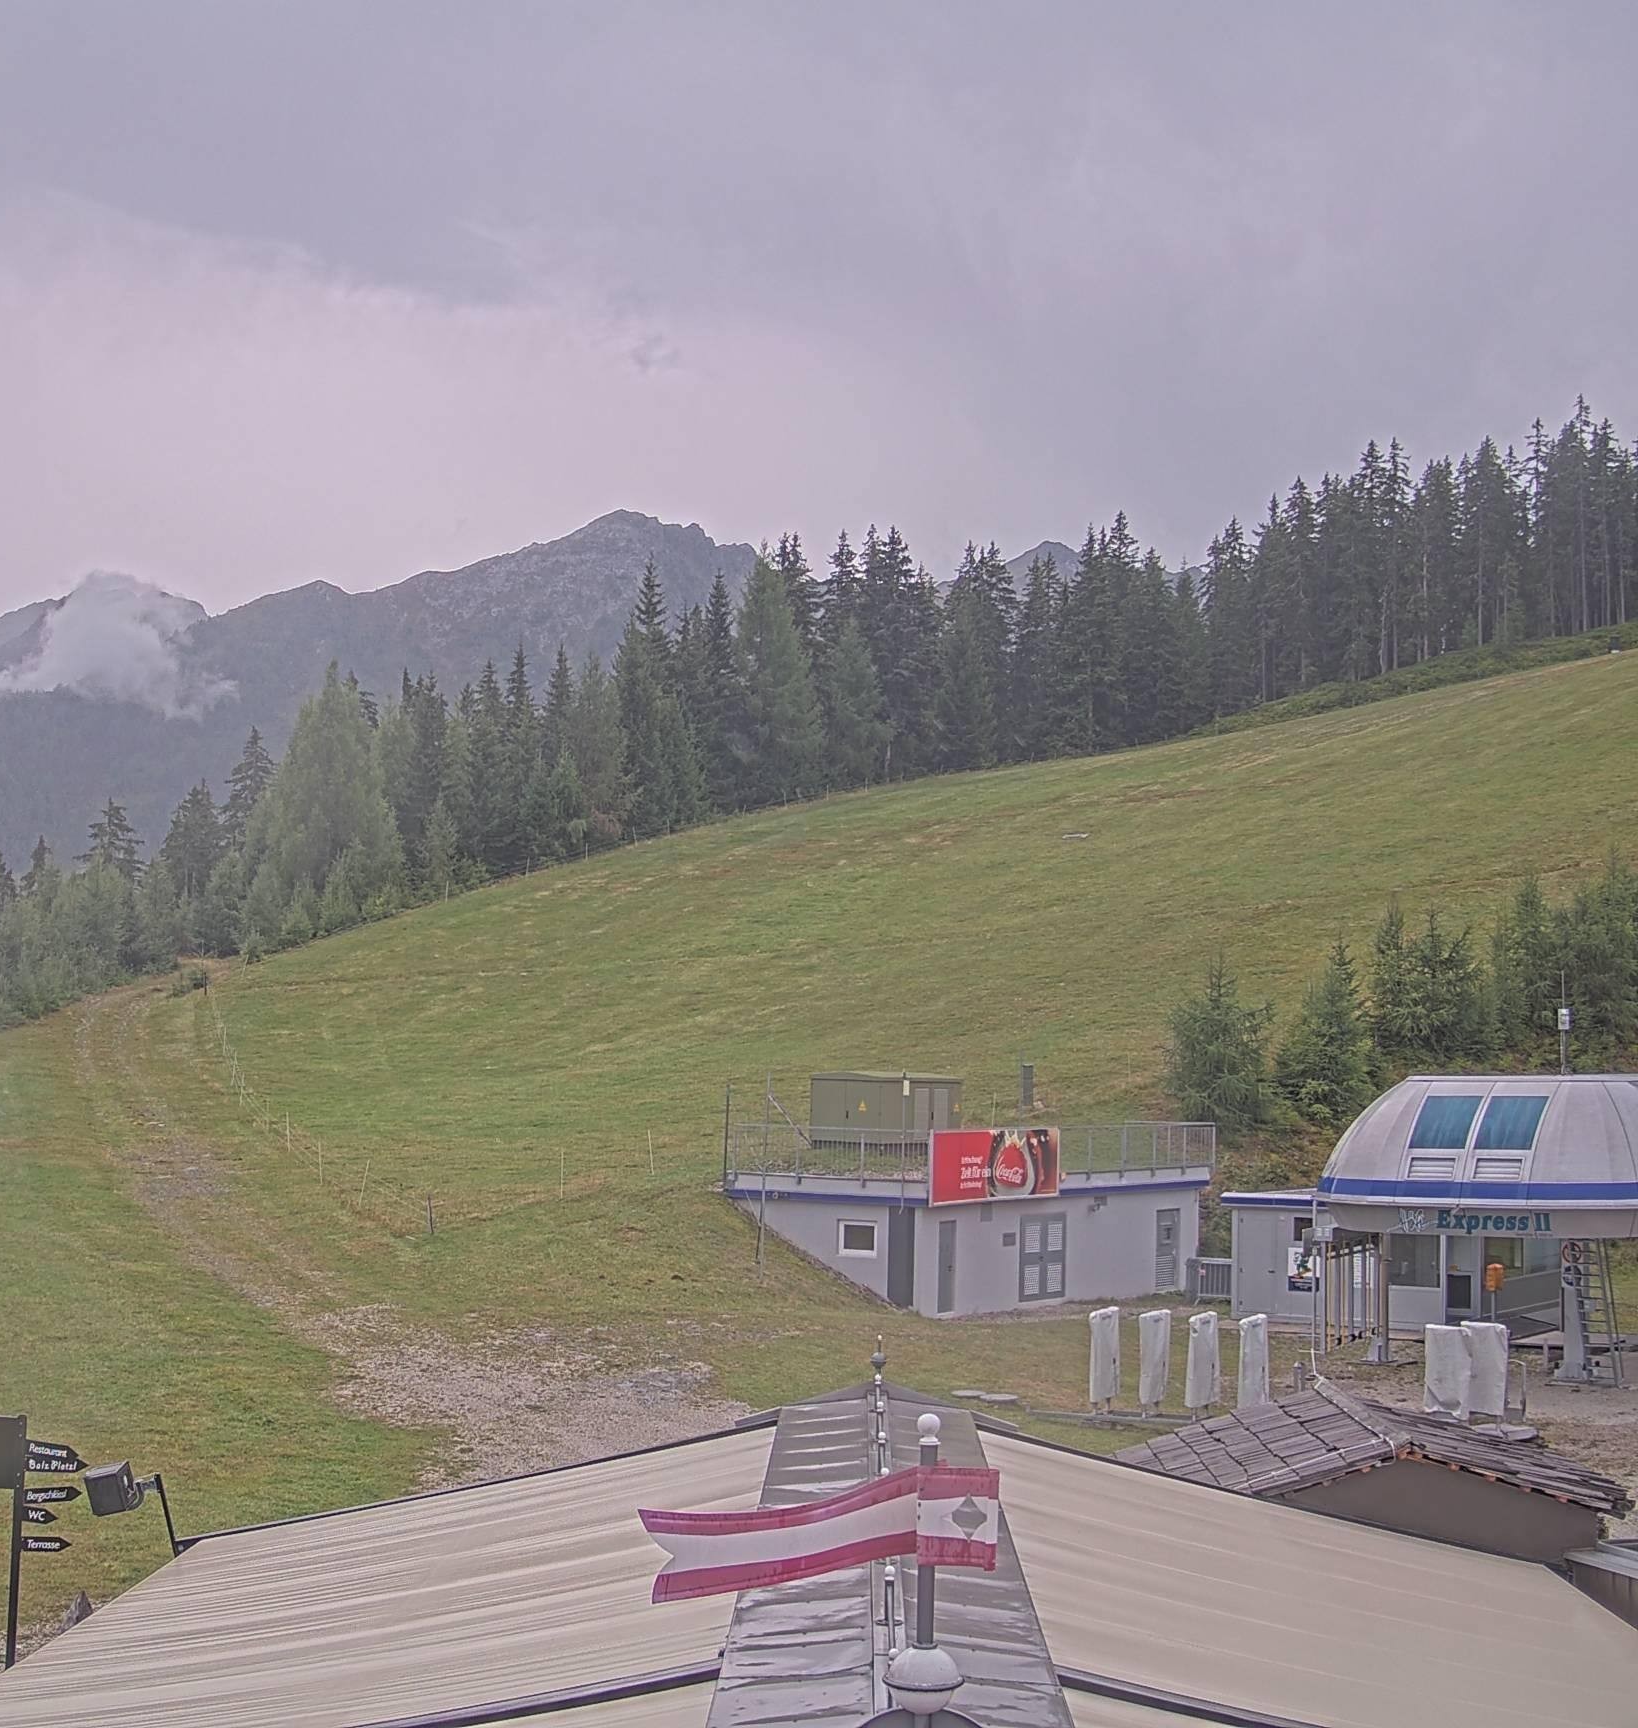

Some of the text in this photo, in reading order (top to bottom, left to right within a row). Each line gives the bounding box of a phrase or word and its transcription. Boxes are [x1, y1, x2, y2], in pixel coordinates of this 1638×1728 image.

[1437, 1209, 1529, 1234] Express
[28, 1510, 46, 1521] WC
[26, 1539, 60, 1549] Terrasse
